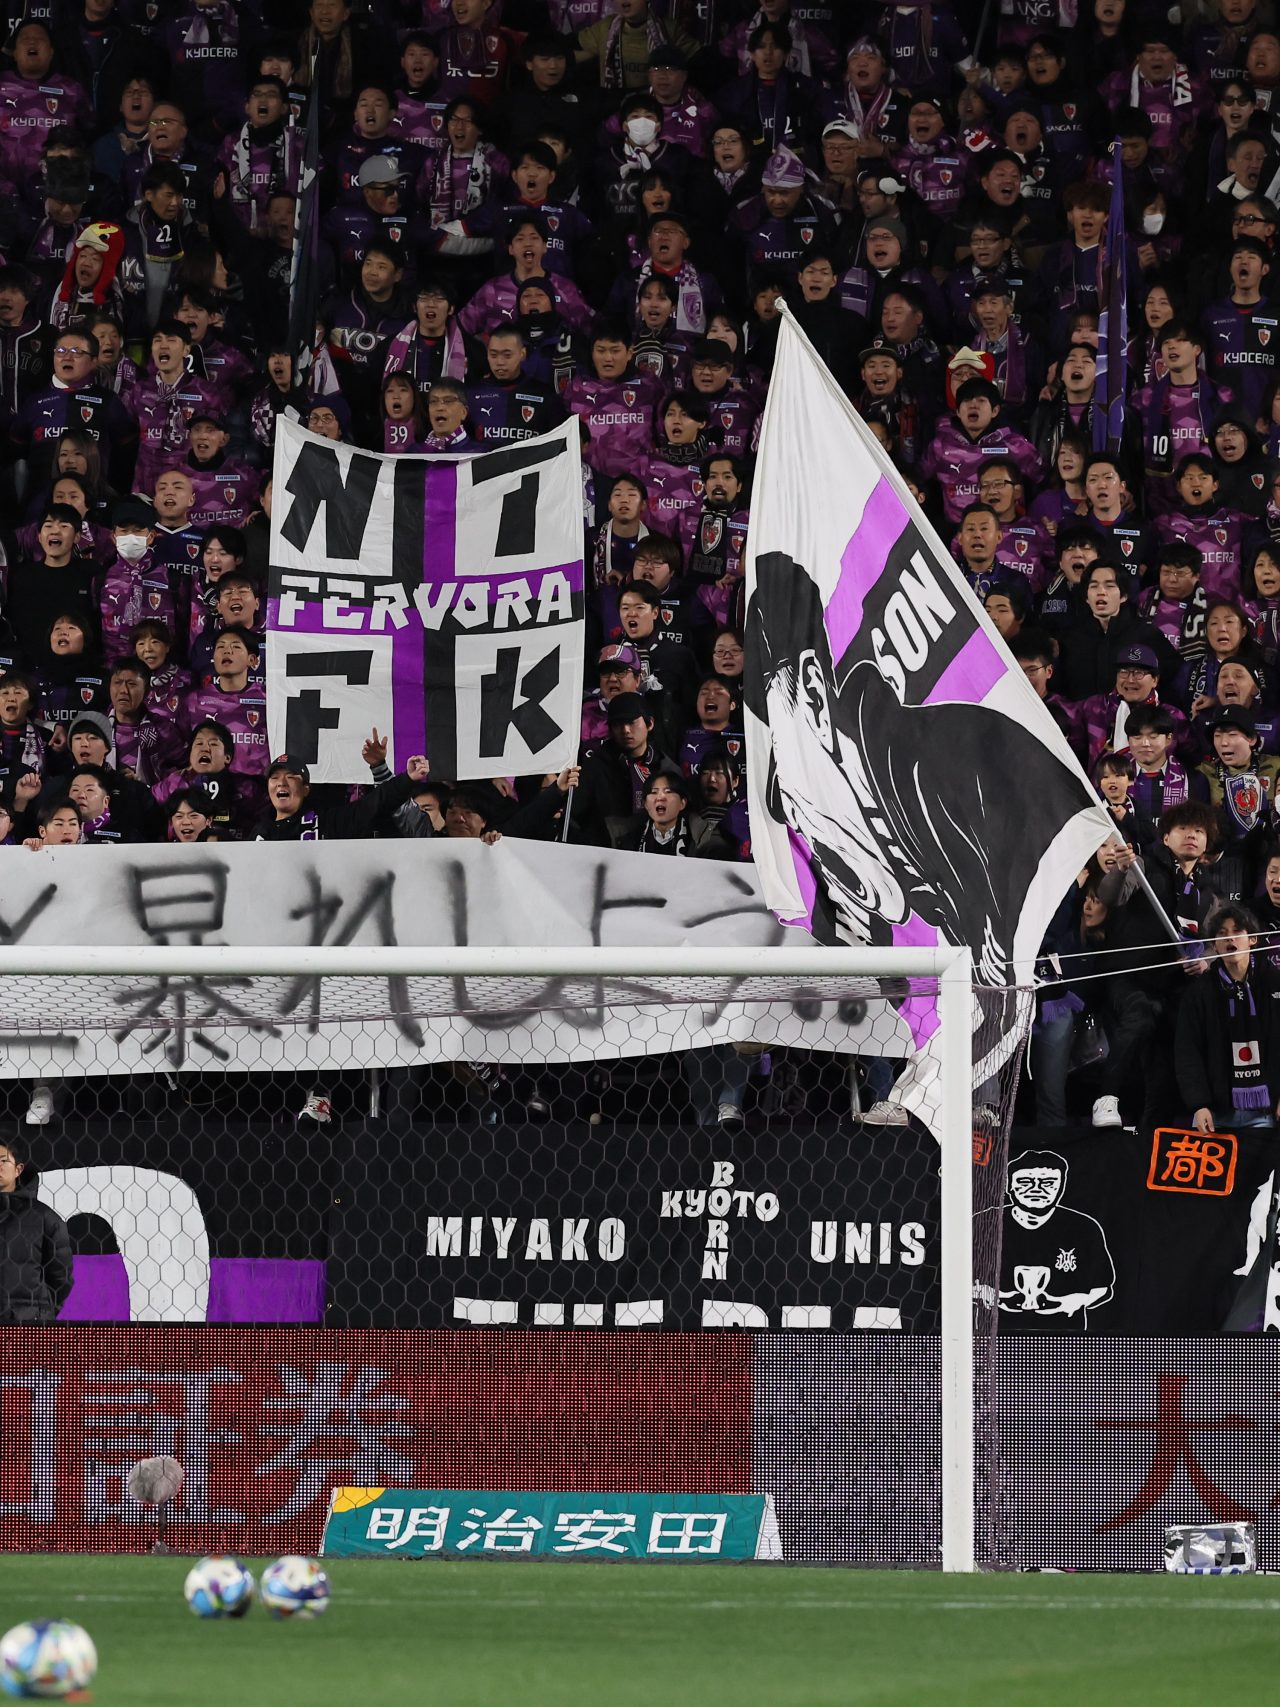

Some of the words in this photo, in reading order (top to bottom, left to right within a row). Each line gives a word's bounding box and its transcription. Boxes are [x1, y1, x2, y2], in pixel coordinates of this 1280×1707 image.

[185, 47, 238, 58] KYOCERA
[1223, 353, 1274, 366] KYOCERA
[590, 413, 643, 424] KYOCERA
[390, 427, 407, 443] 39
[1152, 435, 1168, 456] 10
[191, 509, 243, 521] KYOCERA
[277, 571, 573, 631] FERVORA
[871, 549, 957, 706] SON
[1234, 1069, 1261, 1078] KYOTO
[660, 1189, 780, 1222] KYOTO
[426, 1216, 626, 1262] MIYAKO
[809, 1220, 926, 1266] UNIS
[365, 1505, 728, 1555] 明治安田
